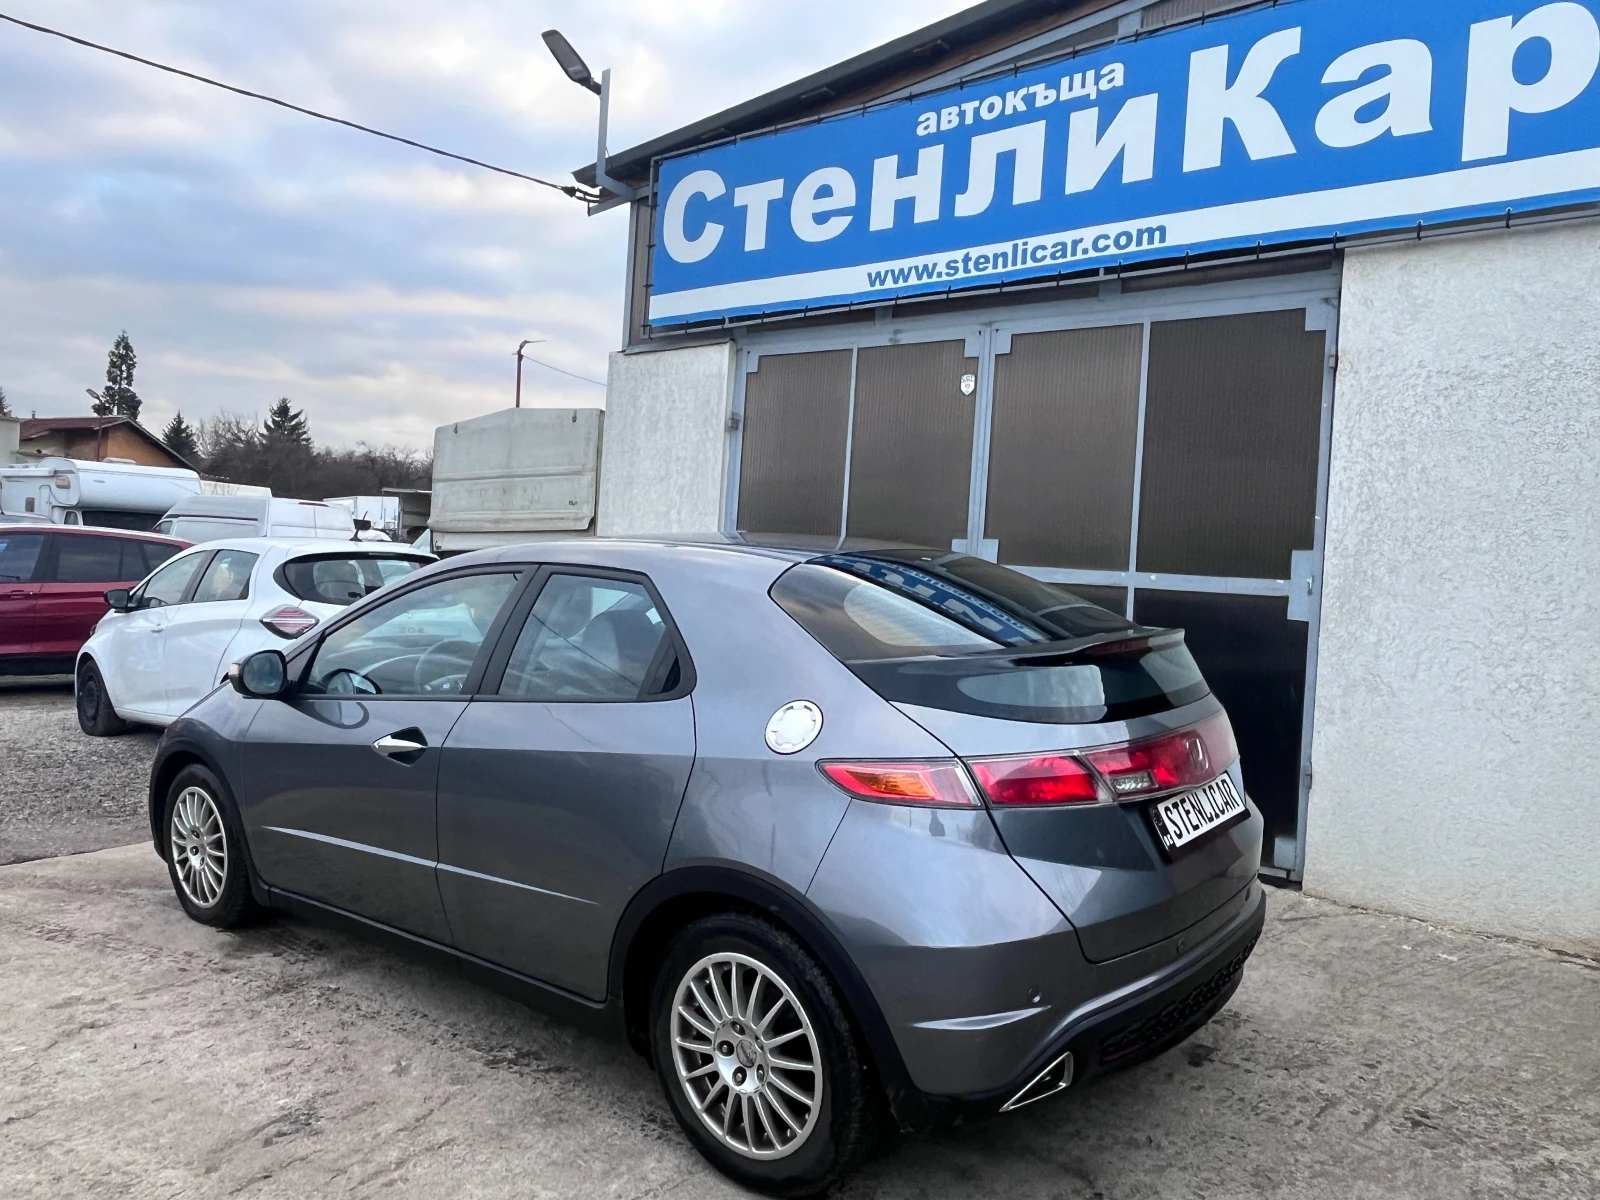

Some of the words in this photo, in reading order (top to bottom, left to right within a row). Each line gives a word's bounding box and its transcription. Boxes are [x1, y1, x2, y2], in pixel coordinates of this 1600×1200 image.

[662, 2, 1600, 264] СтенлиКар
[916, 62, 1125, 136] автокъща
[867, 224, 1166, 287] www.stenlicar.com
[1164, 778, 1240, 840] STENLICAR
